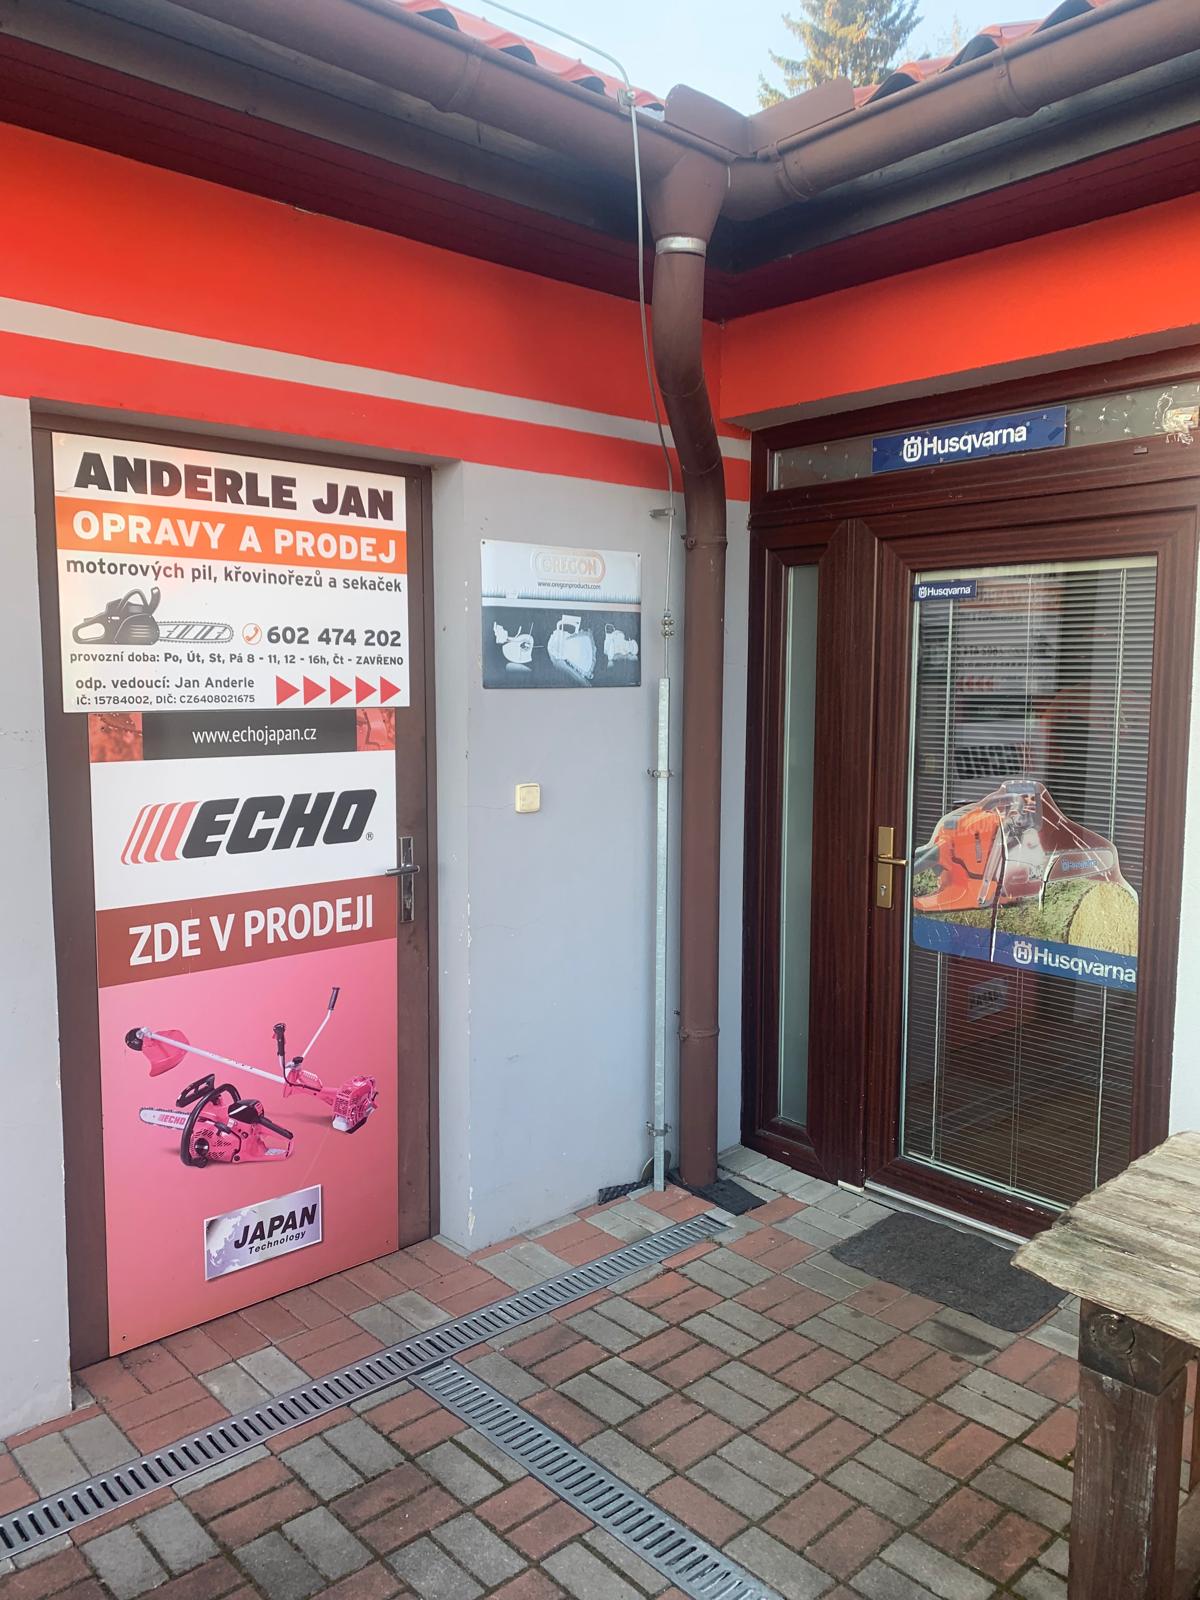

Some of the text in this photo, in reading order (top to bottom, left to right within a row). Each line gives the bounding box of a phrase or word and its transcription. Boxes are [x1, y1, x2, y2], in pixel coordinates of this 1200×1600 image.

[923, 424, 1027, 457] Husqvarna
[74, 451, 394, 521] ANDERLE JAN
[72, 510, 396, 564] OPRAVY A PRODEJ
[66, 556, 402, 592] motorových pil, křovinořezů a sekaček
[542, 557, 597, 575] OREGON
[927, 586, 971, 597] Husqvarna
[267, 626, 402, 647] 602 474 202
[70, 651, 124, 663] provozní
[127, 652, 160, 662] doba:
[164, 652, 182, 664] Po,
[187, 651, 205, 664] Út,
[209, 653, 225, 664] St,
[230, 653, 243, 663] Pá
[247, 653, 255, 663] 8
[268, 654, 280, 665] 11,
[284, 654, 296, 664] 12
[308, 655, 329, 666] 16h,
[333, 653, 344, 665] Čt
[356, 654, 404, 666] ZAVŘENO
[75, 676, 255, 691] odp. vedoucí: Jan Anderle
[76, 693, 255, 706] IČ: 15784002, DIČ: CZ6408021675
[192, 725, 317, 746] www.echojapan.cz
[182, 788, 377, 859] ECHO
[128, 894, 373, 966] ZDE V PRODEJI
[1034, 946, 1136, 984] Husqvarna
[163, 1113, 187, 1126] ECHO
[234, 1203, 317, 1249] JAPAN
[248, 1230, 306, 1255] Technology
